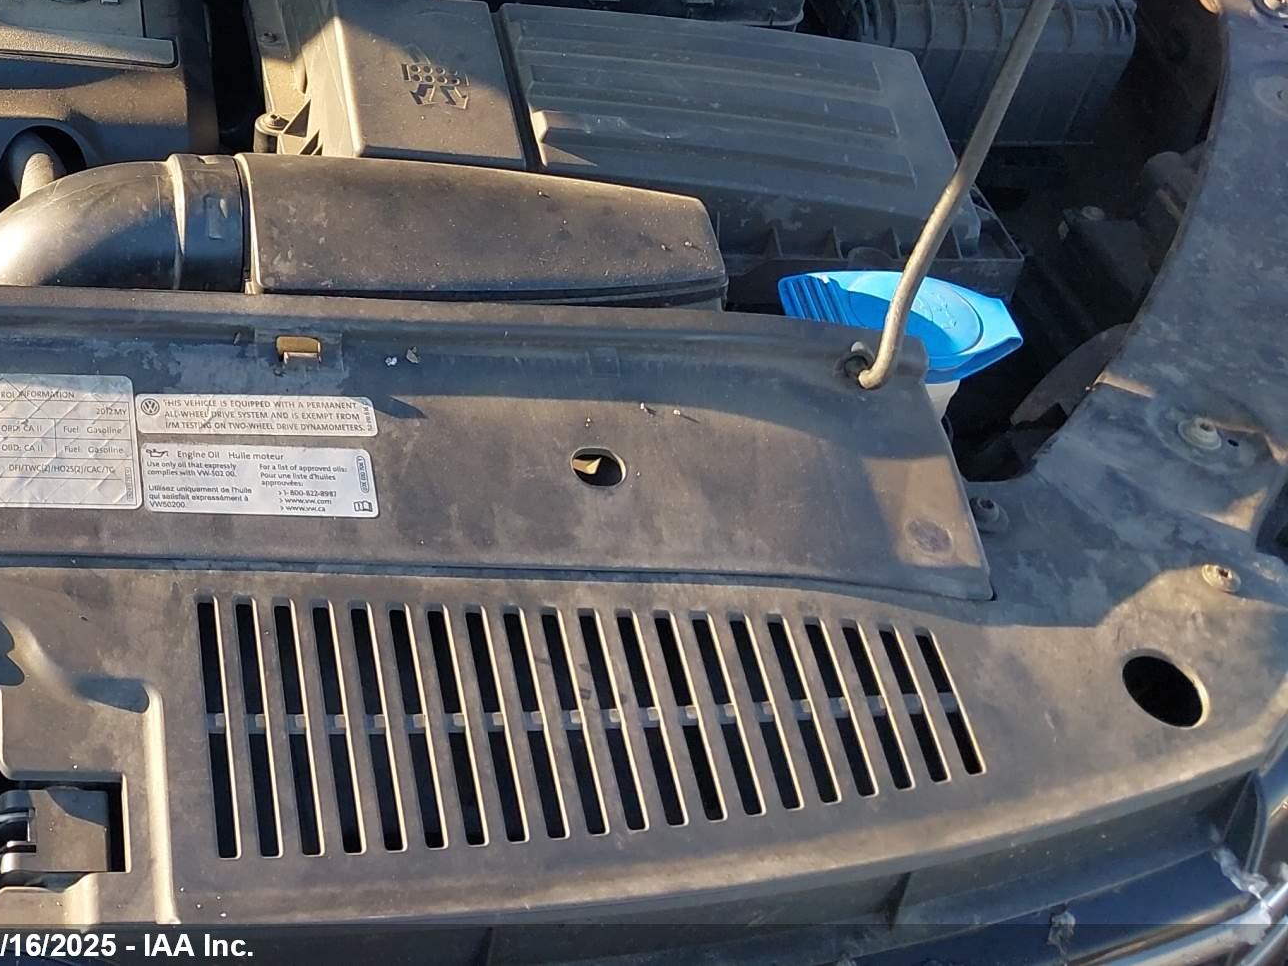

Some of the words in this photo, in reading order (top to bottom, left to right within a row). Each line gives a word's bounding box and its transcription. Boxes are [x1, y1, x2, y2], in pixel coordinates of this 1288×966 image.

[163, 399, 181, 407] THIS
[184, 399, 216, 407] VEHICLE
[220, 399, 227, 407] IS
[230, 400, 270, 408] EQUIPPED
[306, 401, 357, 409] PERMANENT
[86, 426, 122, 434] Gasoline
[229, 422, 275, 430] TWO-WHEEL
[301, 423, 365, 431] DYNAMOMETERS.
[1, 444, 22, 452] OBD:
[24, 444, 34, 452] CA
[87, 445, 123, 454] Gasoline
[177, 450, 205, 459] Engine
[147, 469, 177, 477] complies
[177, 485, 218, 493] uniquement
